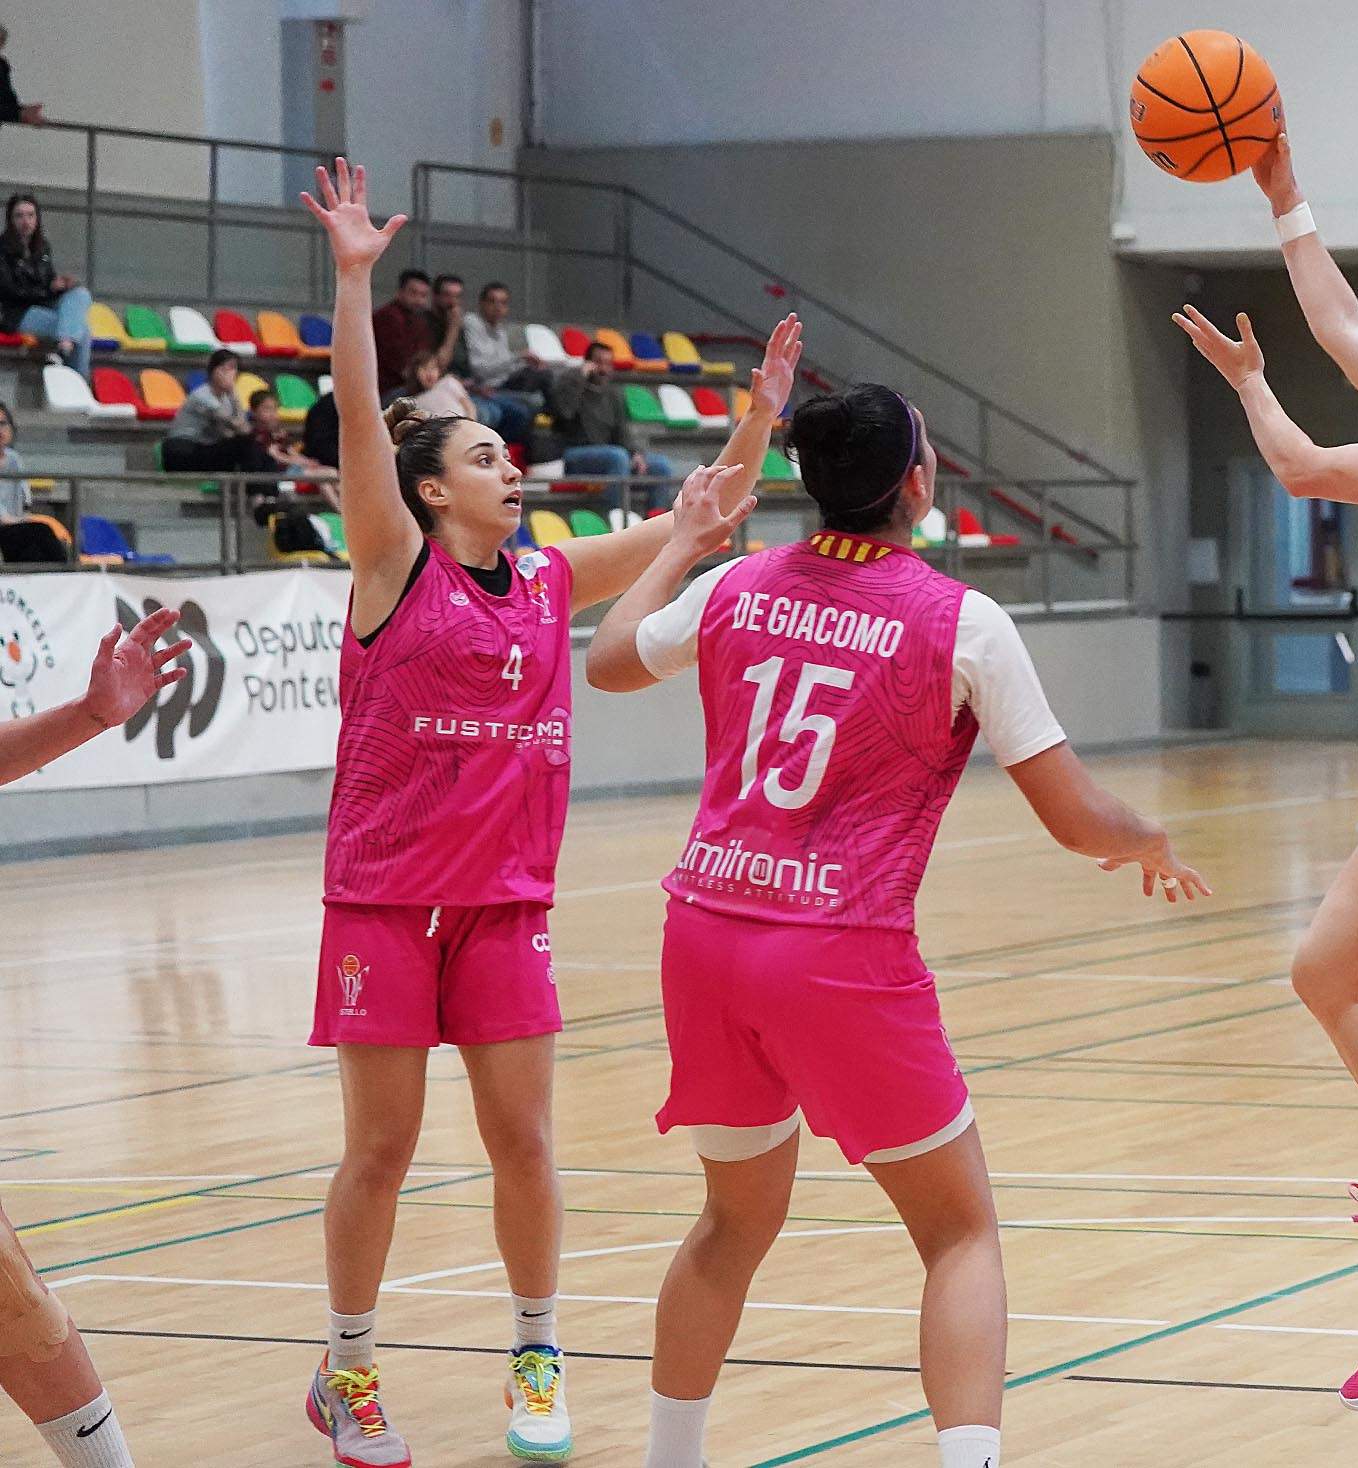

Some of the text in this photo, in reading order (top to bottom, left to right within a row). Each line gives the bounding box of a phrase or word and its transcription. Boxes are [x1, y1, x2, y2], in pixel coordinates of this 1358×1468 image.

[732, 591, 905, 658] DE GIACOMO
[501, 644, 523, 691] 4
[737, 655, 856, 810] 15
